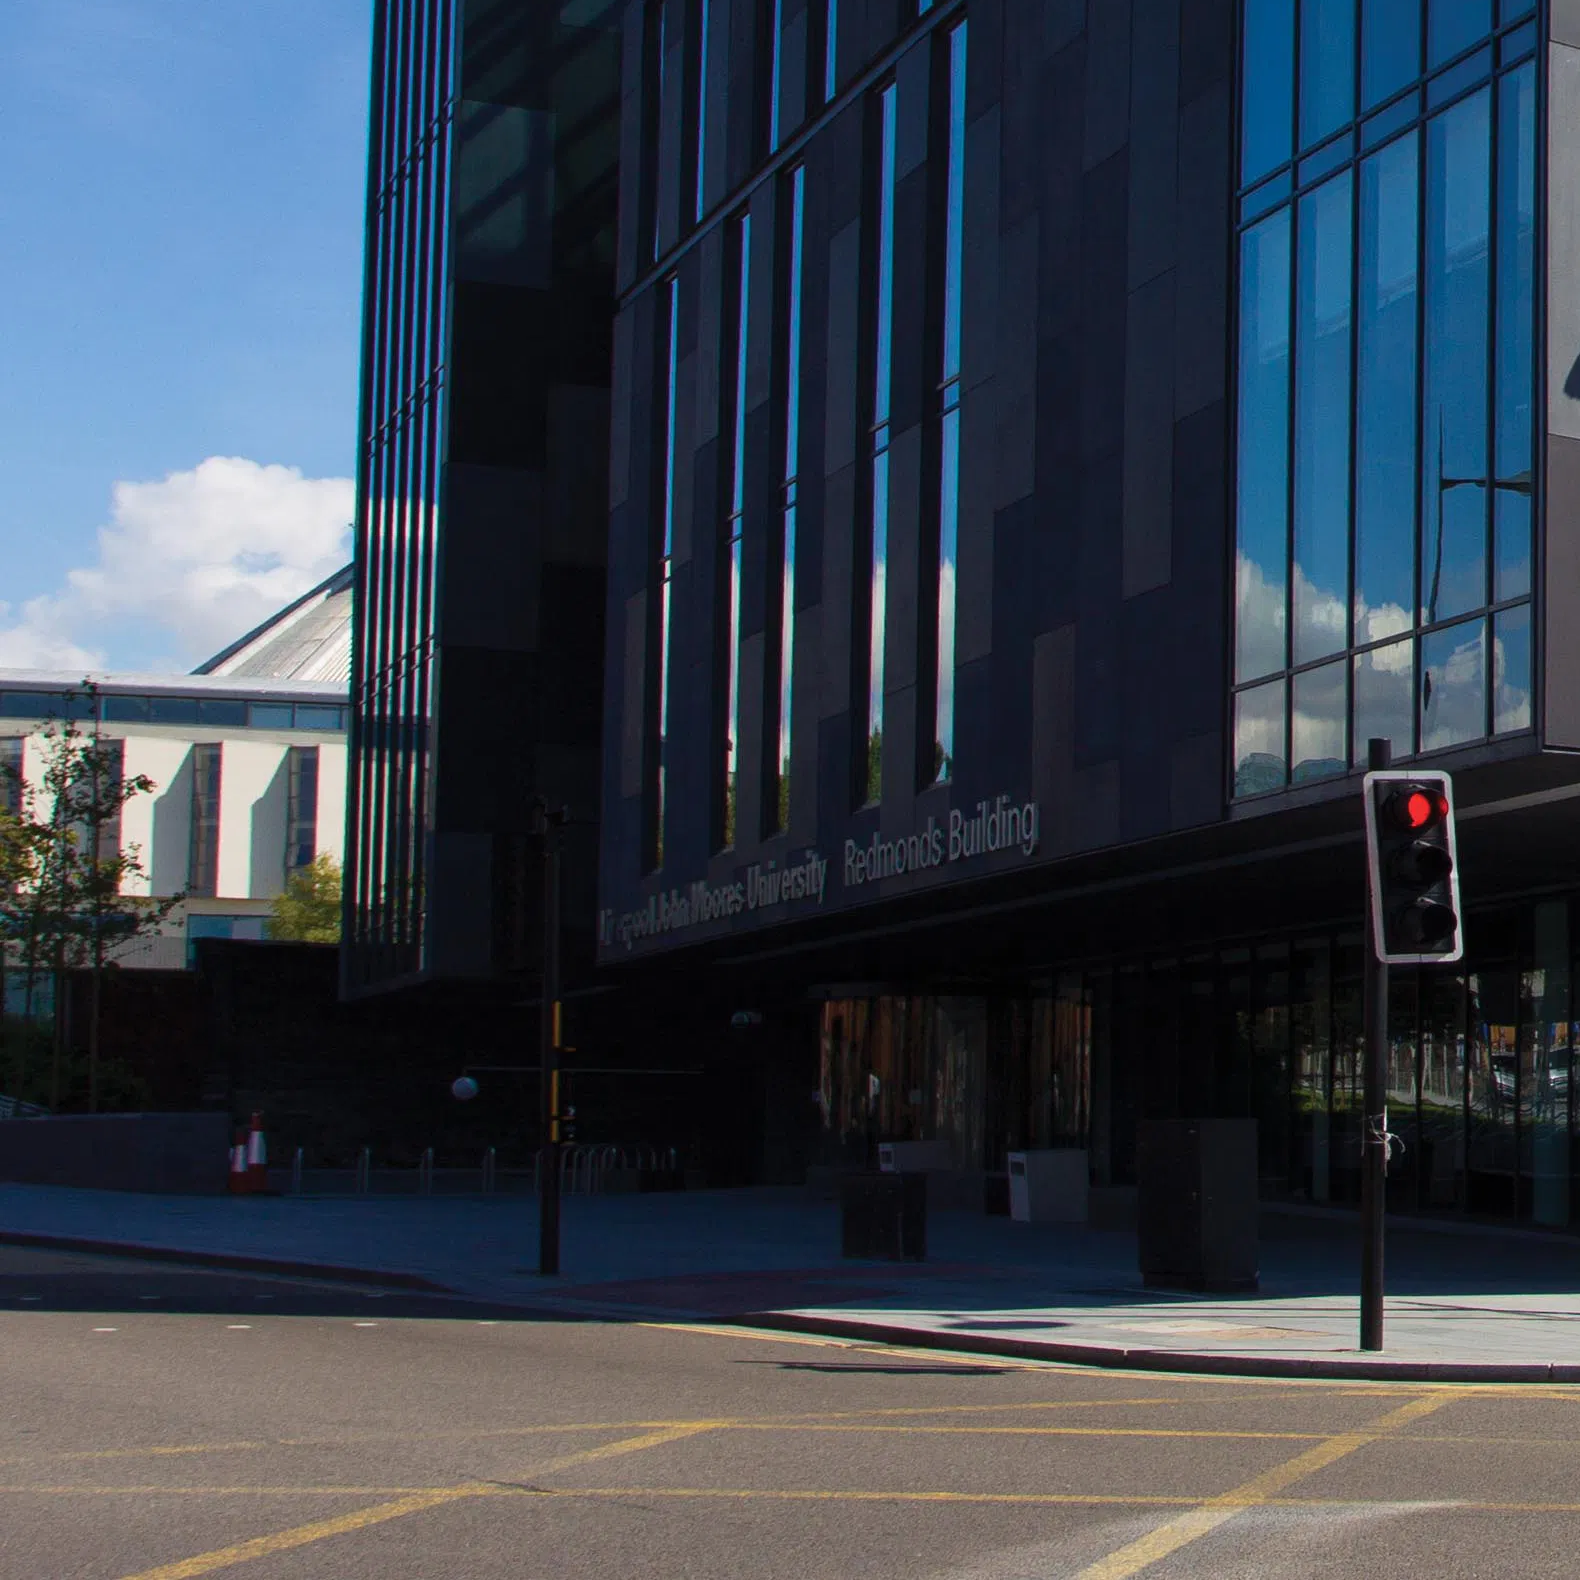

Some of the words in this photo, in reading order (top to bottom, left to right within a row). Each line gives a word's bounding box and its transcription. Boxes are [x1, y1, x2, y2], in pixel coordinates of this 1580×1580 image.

[691, 879, 744, 922] Moores
[747, 850, 827, 906] University
[844, 817, 944, 887] Redmonds
[949, 795, 1040, 861] Building
